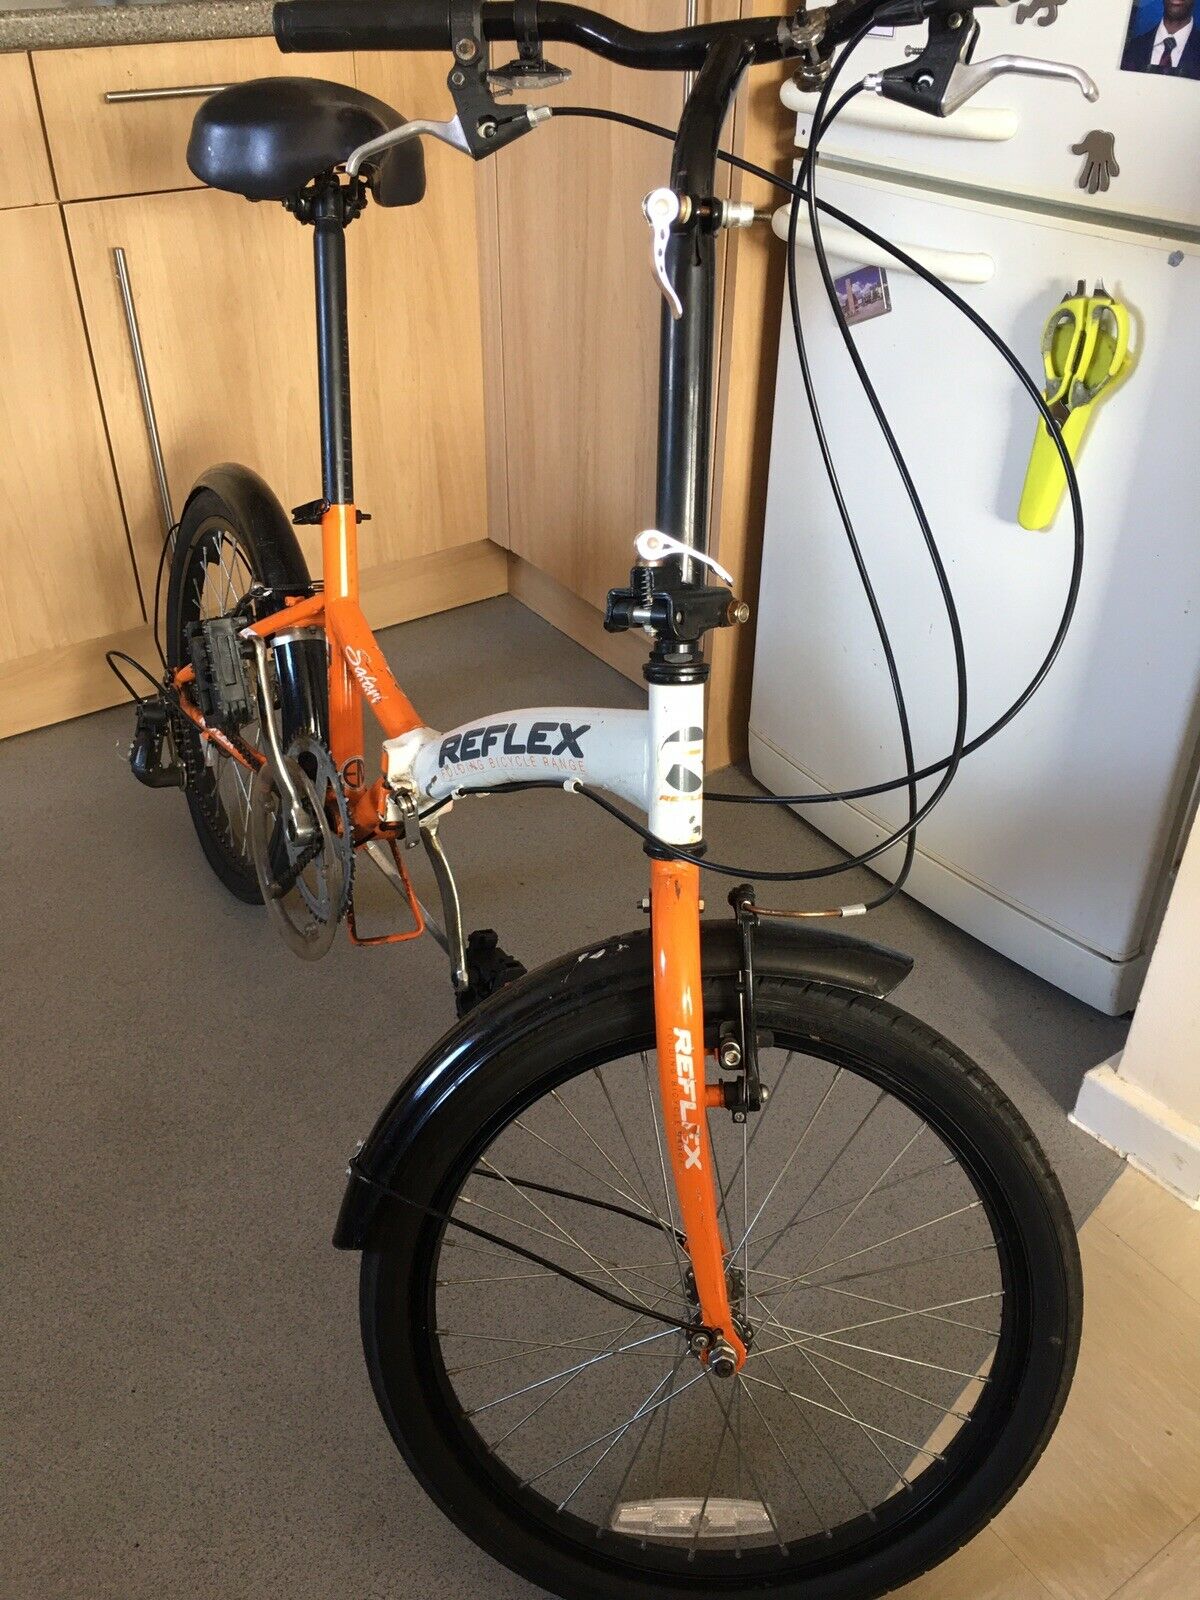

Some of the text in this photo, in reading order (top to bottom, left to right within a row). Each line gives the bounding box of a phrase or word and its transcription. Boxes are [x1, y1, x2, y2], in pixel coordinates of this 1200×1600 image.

[345, 645, 383, 704] Safari
[438, 721, 592, 768] REFLEX
[488, 756, 536, 769] BICYCLE
[542, 757, 586, 773] RANGE
